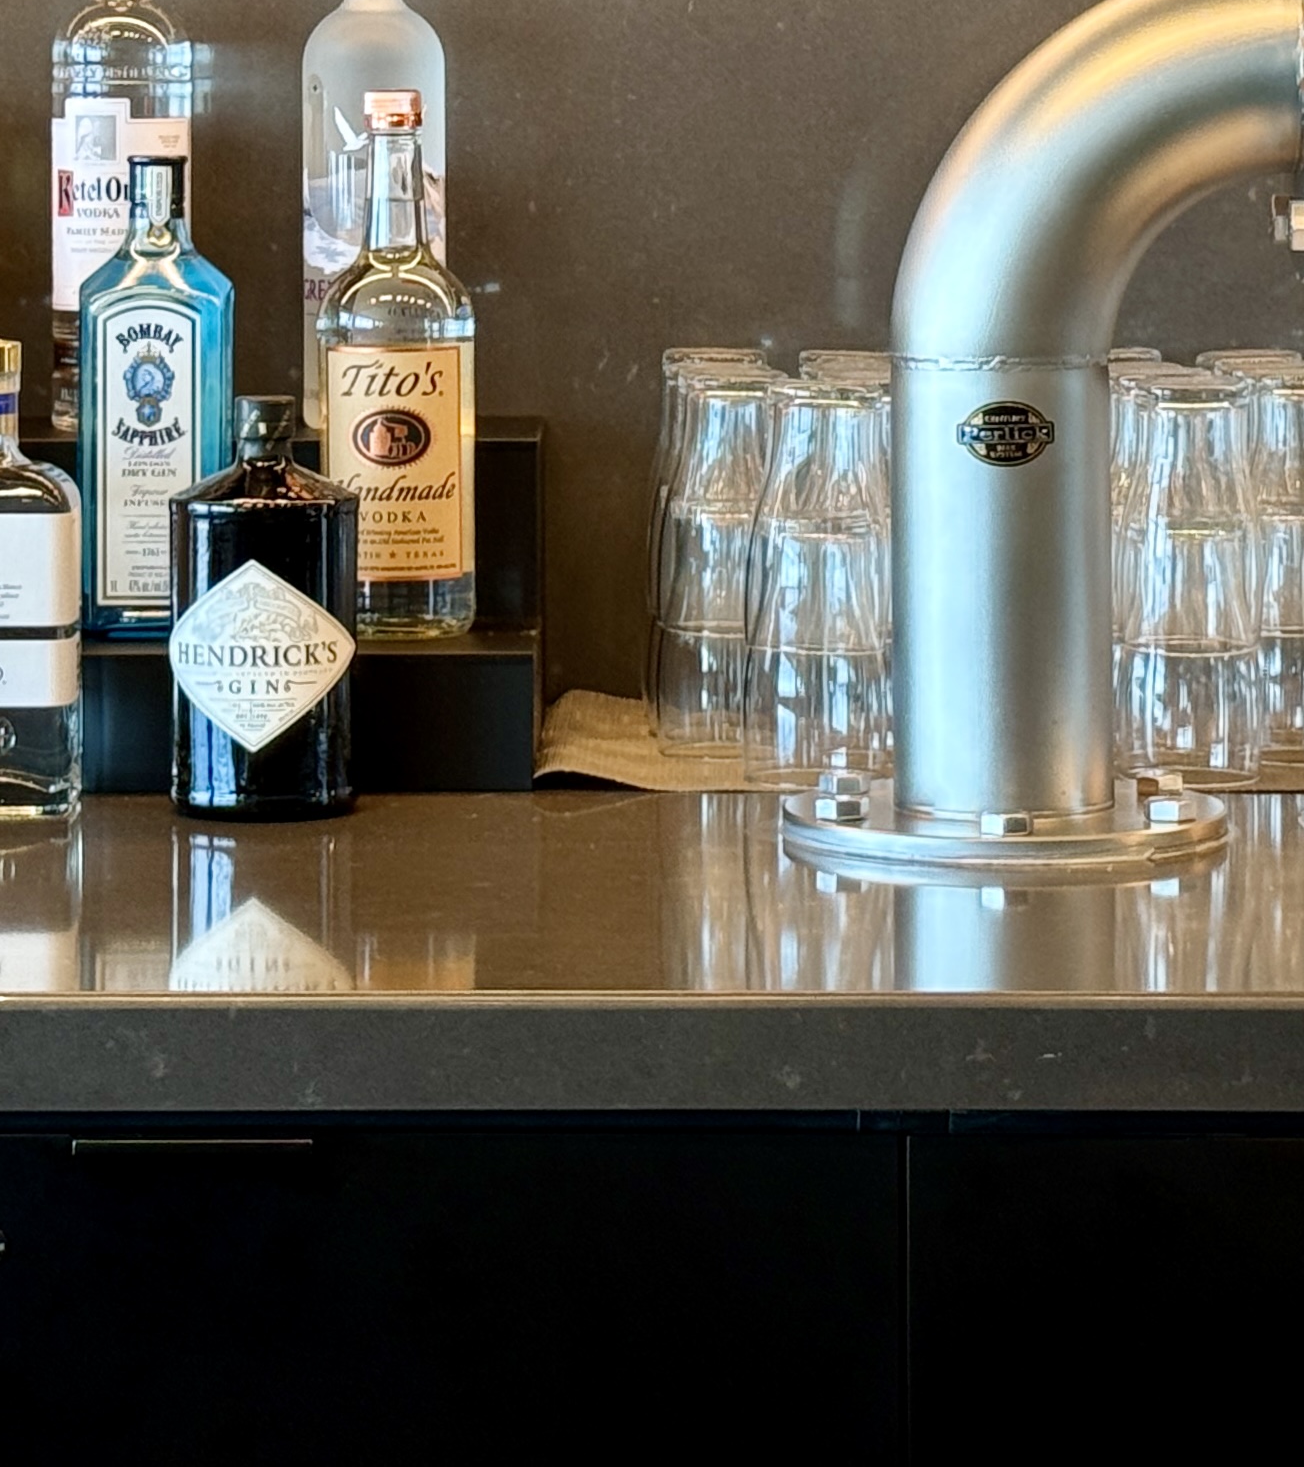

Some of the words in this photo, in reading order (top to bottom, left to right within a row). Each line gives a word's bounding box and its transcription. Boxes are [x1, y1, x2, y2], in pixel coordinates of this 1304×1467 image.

[59, 174, 103, 214] Ketel
[76, 208, 120, 218] VODKA
[304, 279, 333, 300] GRE
[115, 323, 184, 354] BOMBAY
[341, 359, 444, 397] Tito's
[111, 416, 188, 446] SAPPHIRE
[121, 468, 147, 477] DRY
[151, 468, 178, 477] GIN
[360, 511, 427, 523] VODKA
[178, 640, 339, 668] HENDRICK'S
[229, 680, 279, 695] GIN
